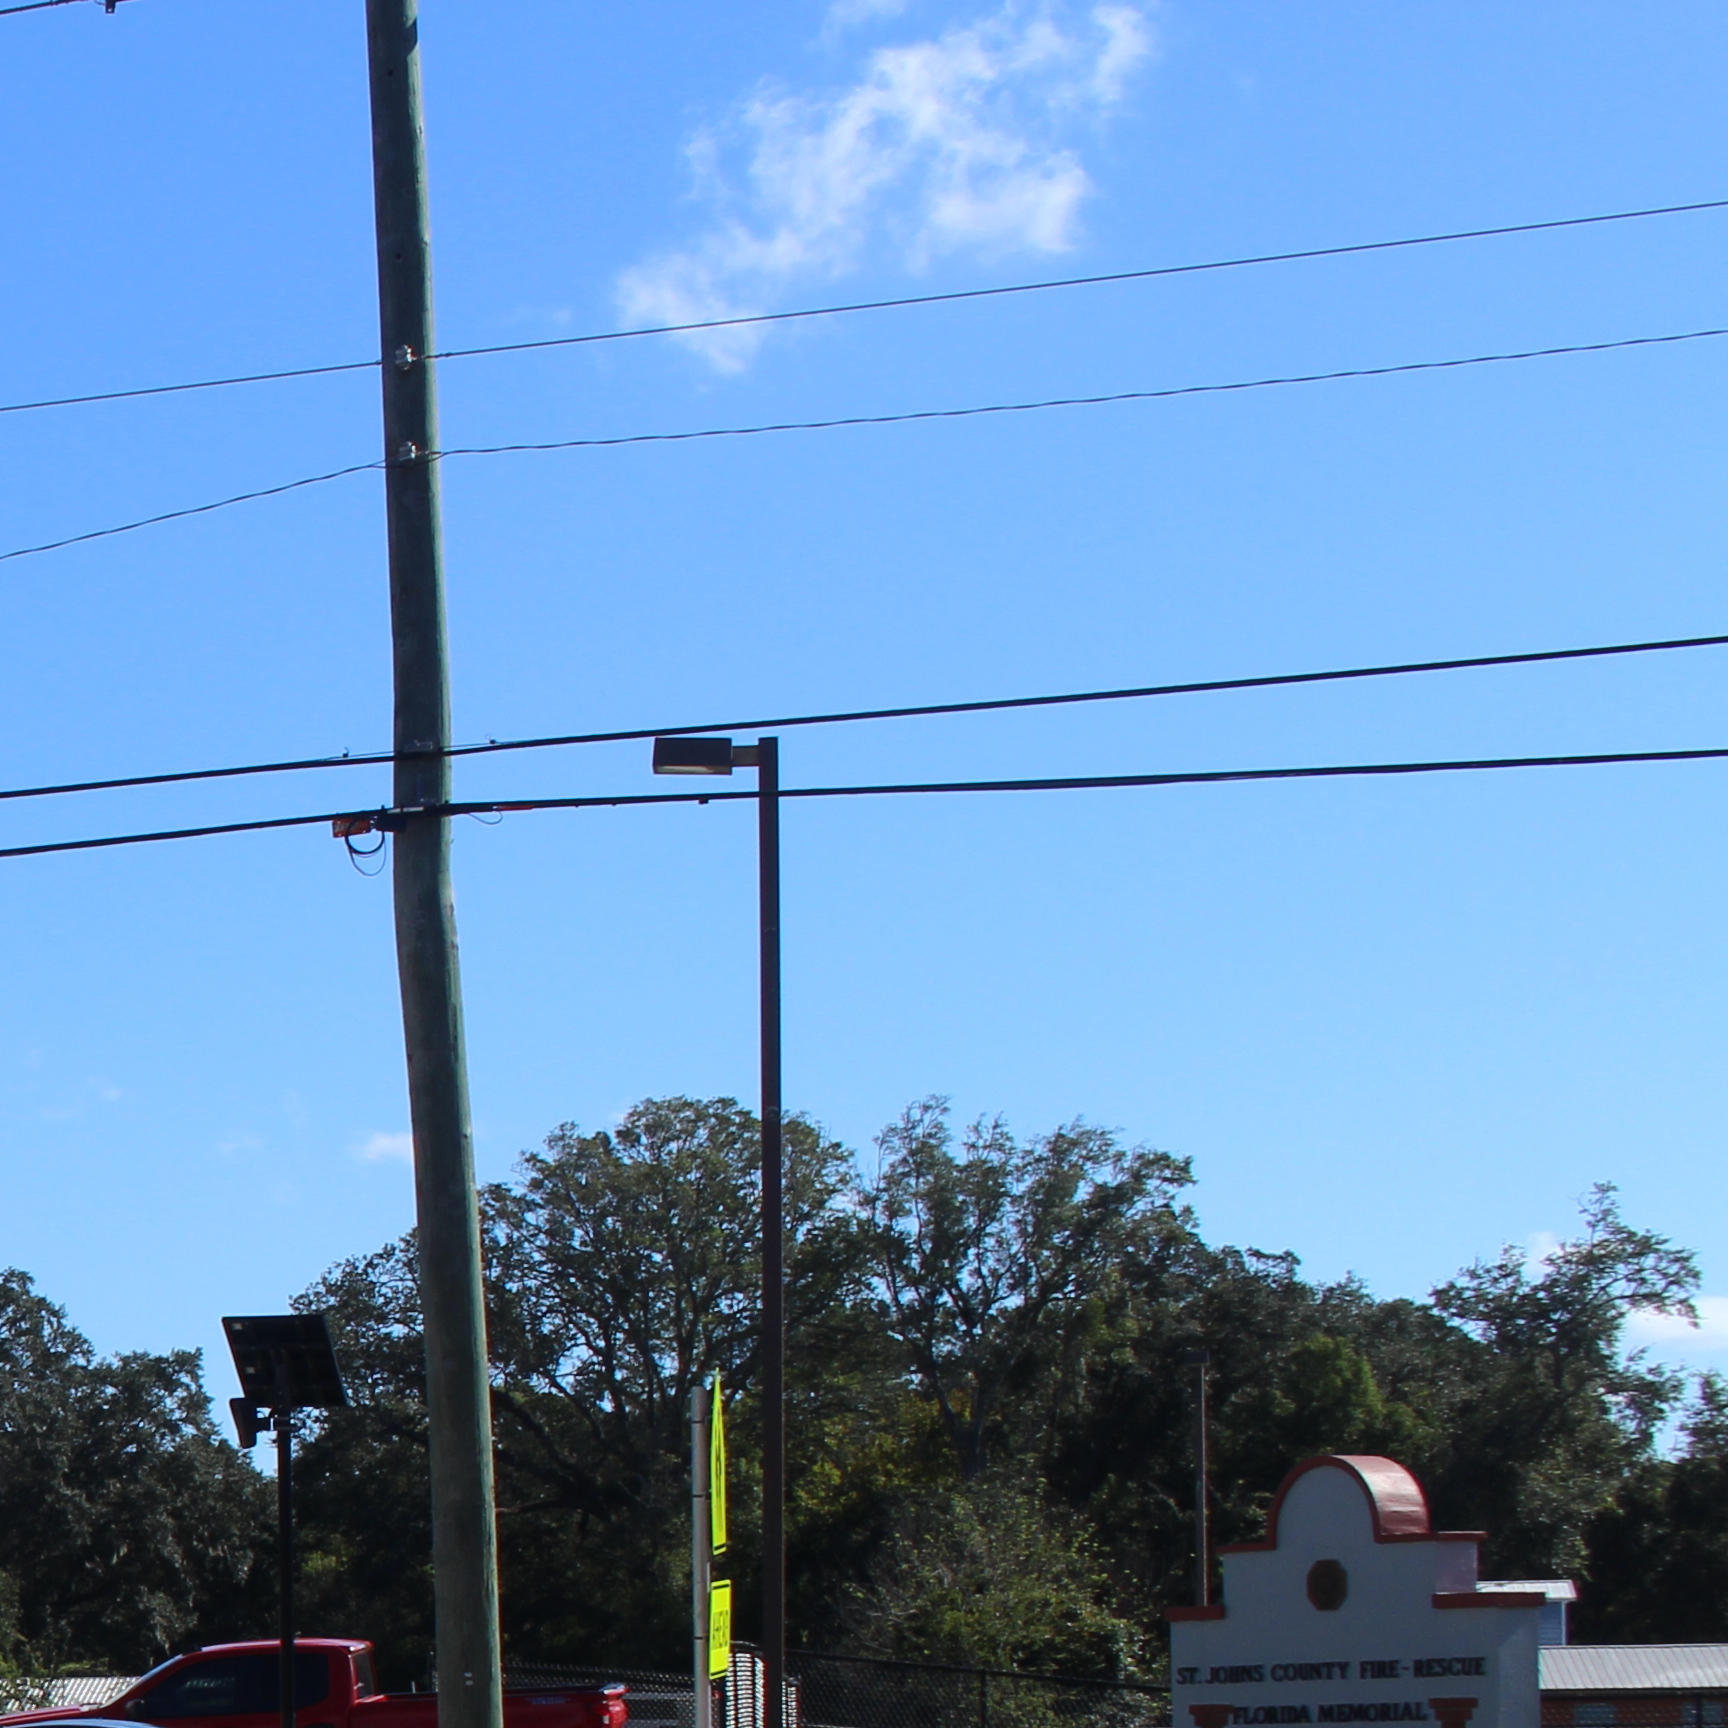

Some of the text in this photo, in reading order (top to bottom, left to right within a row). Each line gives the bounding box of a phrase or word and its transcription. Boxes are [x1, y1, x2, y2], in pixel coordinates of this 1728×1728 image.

[1176, 1667, 1203, 1685] ST.
[1205, 1664, 1264, 1684] JOHNS
[1270, 1661, 1350, 1682] COUNTY
[1232, 1701, 1429, 1725] FLORIDA MEMORIAL
